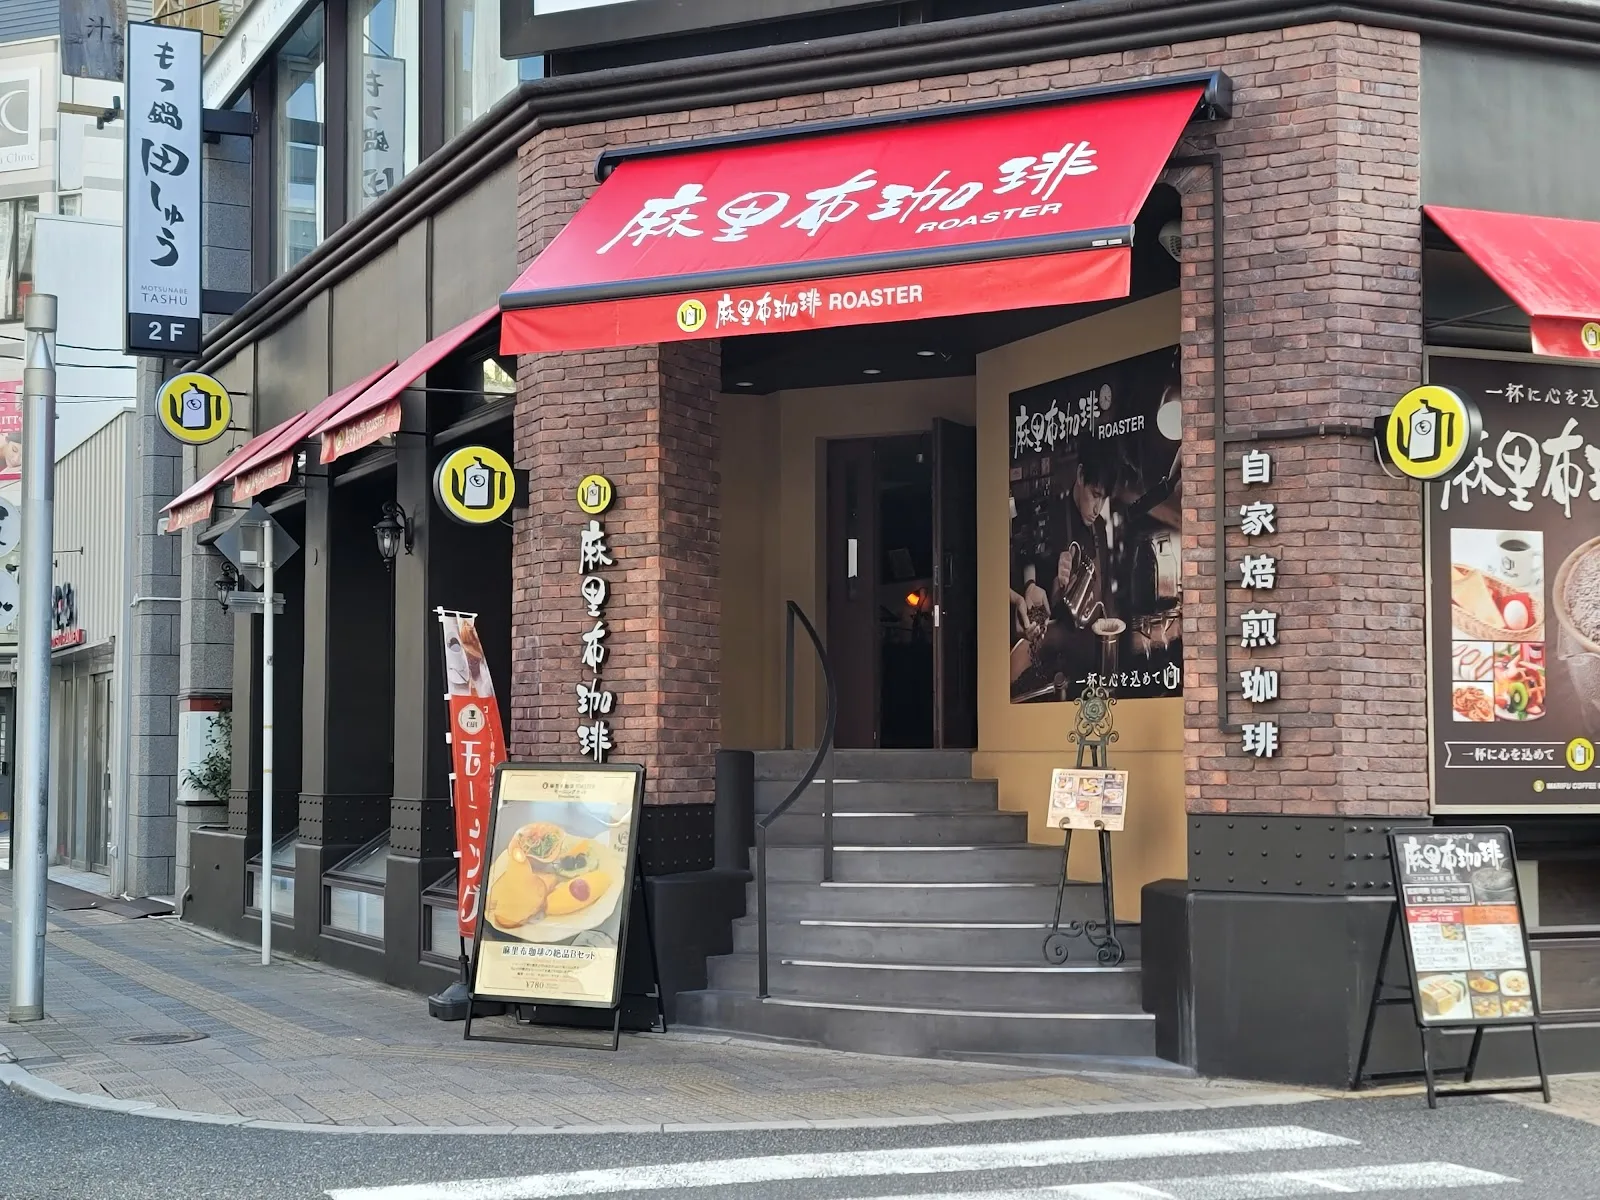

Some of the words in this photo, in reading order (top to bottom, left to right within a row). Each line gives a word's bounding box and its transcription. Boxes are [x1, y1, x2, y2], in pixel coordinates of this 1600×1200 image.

[85, 16, 111, 41] 汁
[6, 151, 35, 164] Clinic
[597, 141, 1098, 255] 麻里布珈琲
[915, 202, 1063, 234] ROASTER
[141, 284, 188, 294] MOTSUNABE
[141, 292, 188, 306] TASHU
[715, 289, 823, 329] 麻里布珈琲
[828, 285, 923, 311] ROASTER
[1014, 390, 1100, 459] 麻里布珈琲
[1098, 415, 1145, 440] ROASTER
[1239, 449, 1279, 758] 自家焙煎珈琲
[576, 519, 613, 763] 麻里布珈琲
[1075, 670, 1161, 688] 一杯に心を込めて
[1461, 747, 1555, 762] 一杯に心を込めて
[460, 739, 482, 923] モーニング
[1403, 836, 1504, 875] 麻里布珈琲
